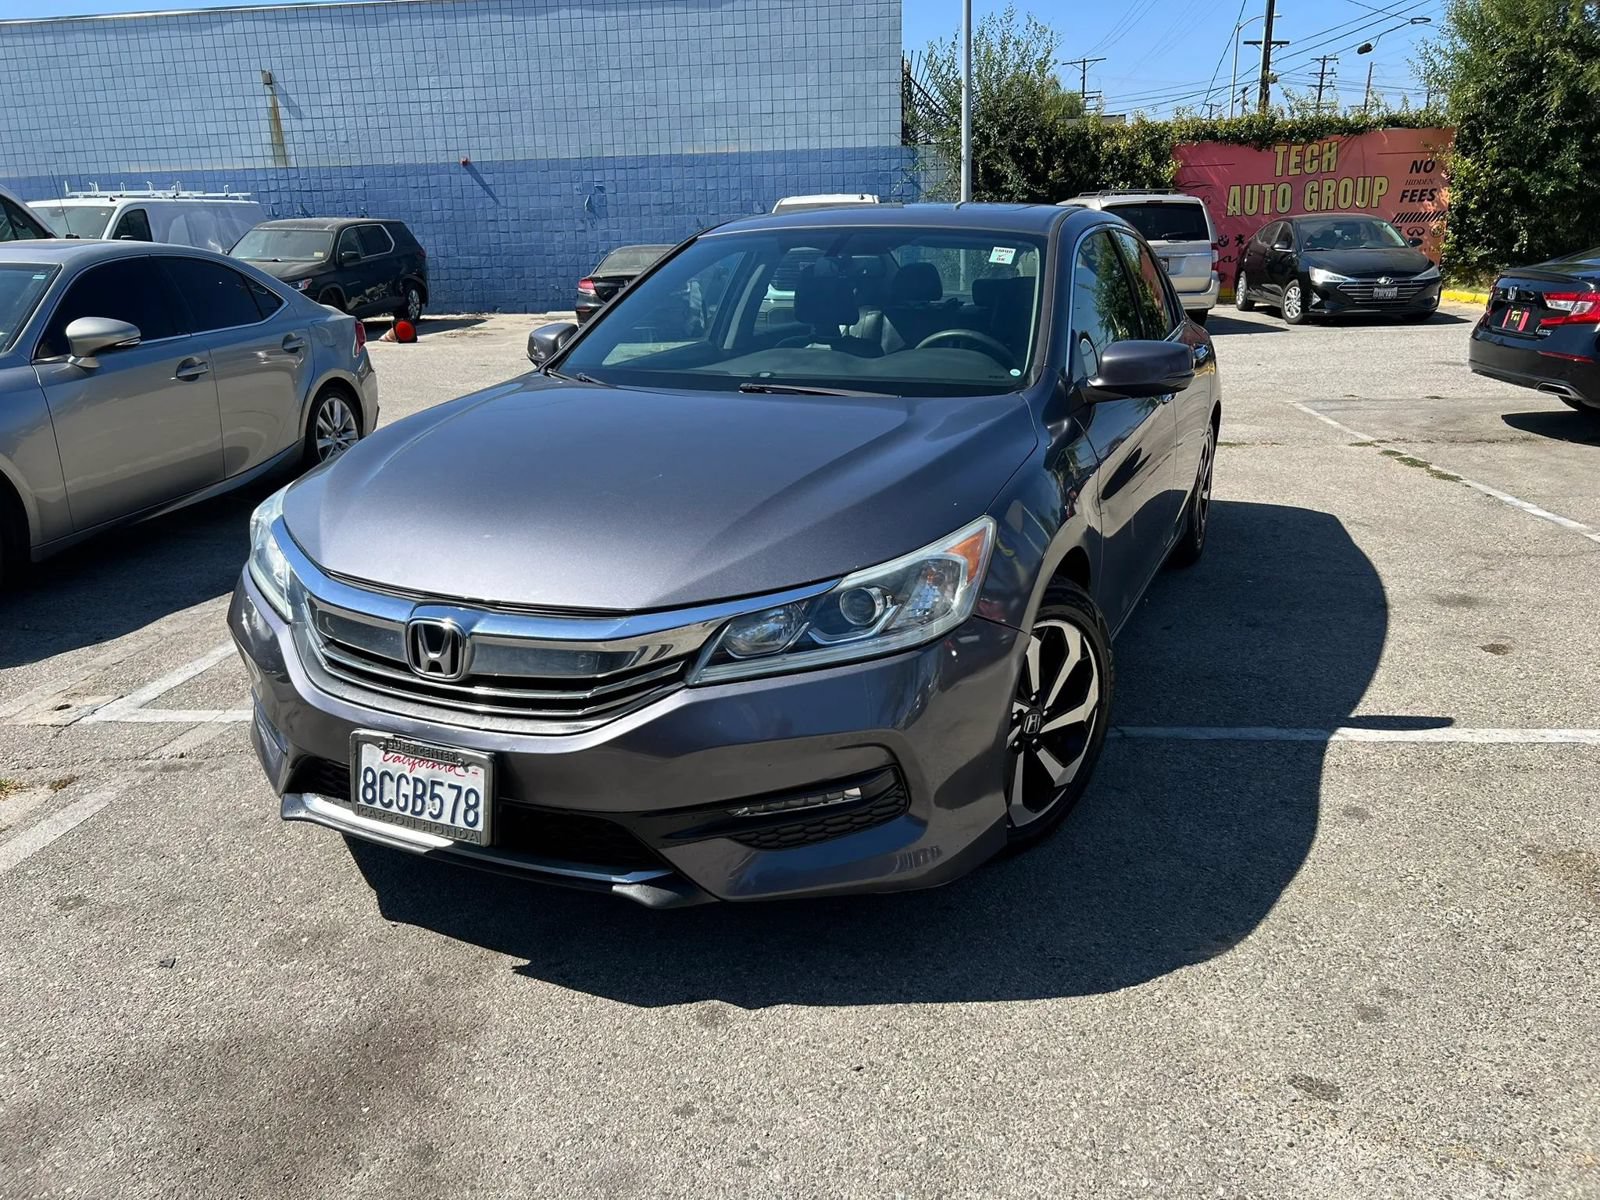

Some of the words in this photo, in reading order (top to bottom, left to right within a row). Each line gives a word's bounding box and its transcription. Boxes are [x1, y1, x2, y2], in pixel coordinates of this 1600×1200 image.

[1273, 141, 1339, 177] TECH
[1409, 159, 1436, 174] NO
[1225, 182, 1293, 217] AUTO
[1302, 175, 1390, 213] GROUP
[1399, 187, 1438, 203] FEES
[418, 746, 456, 762] CENTER
[361, 766, 480, 828] 8CGB578
[359, 805, 416, 828] CARSON
[422, 821, 480, 843] HONDA
